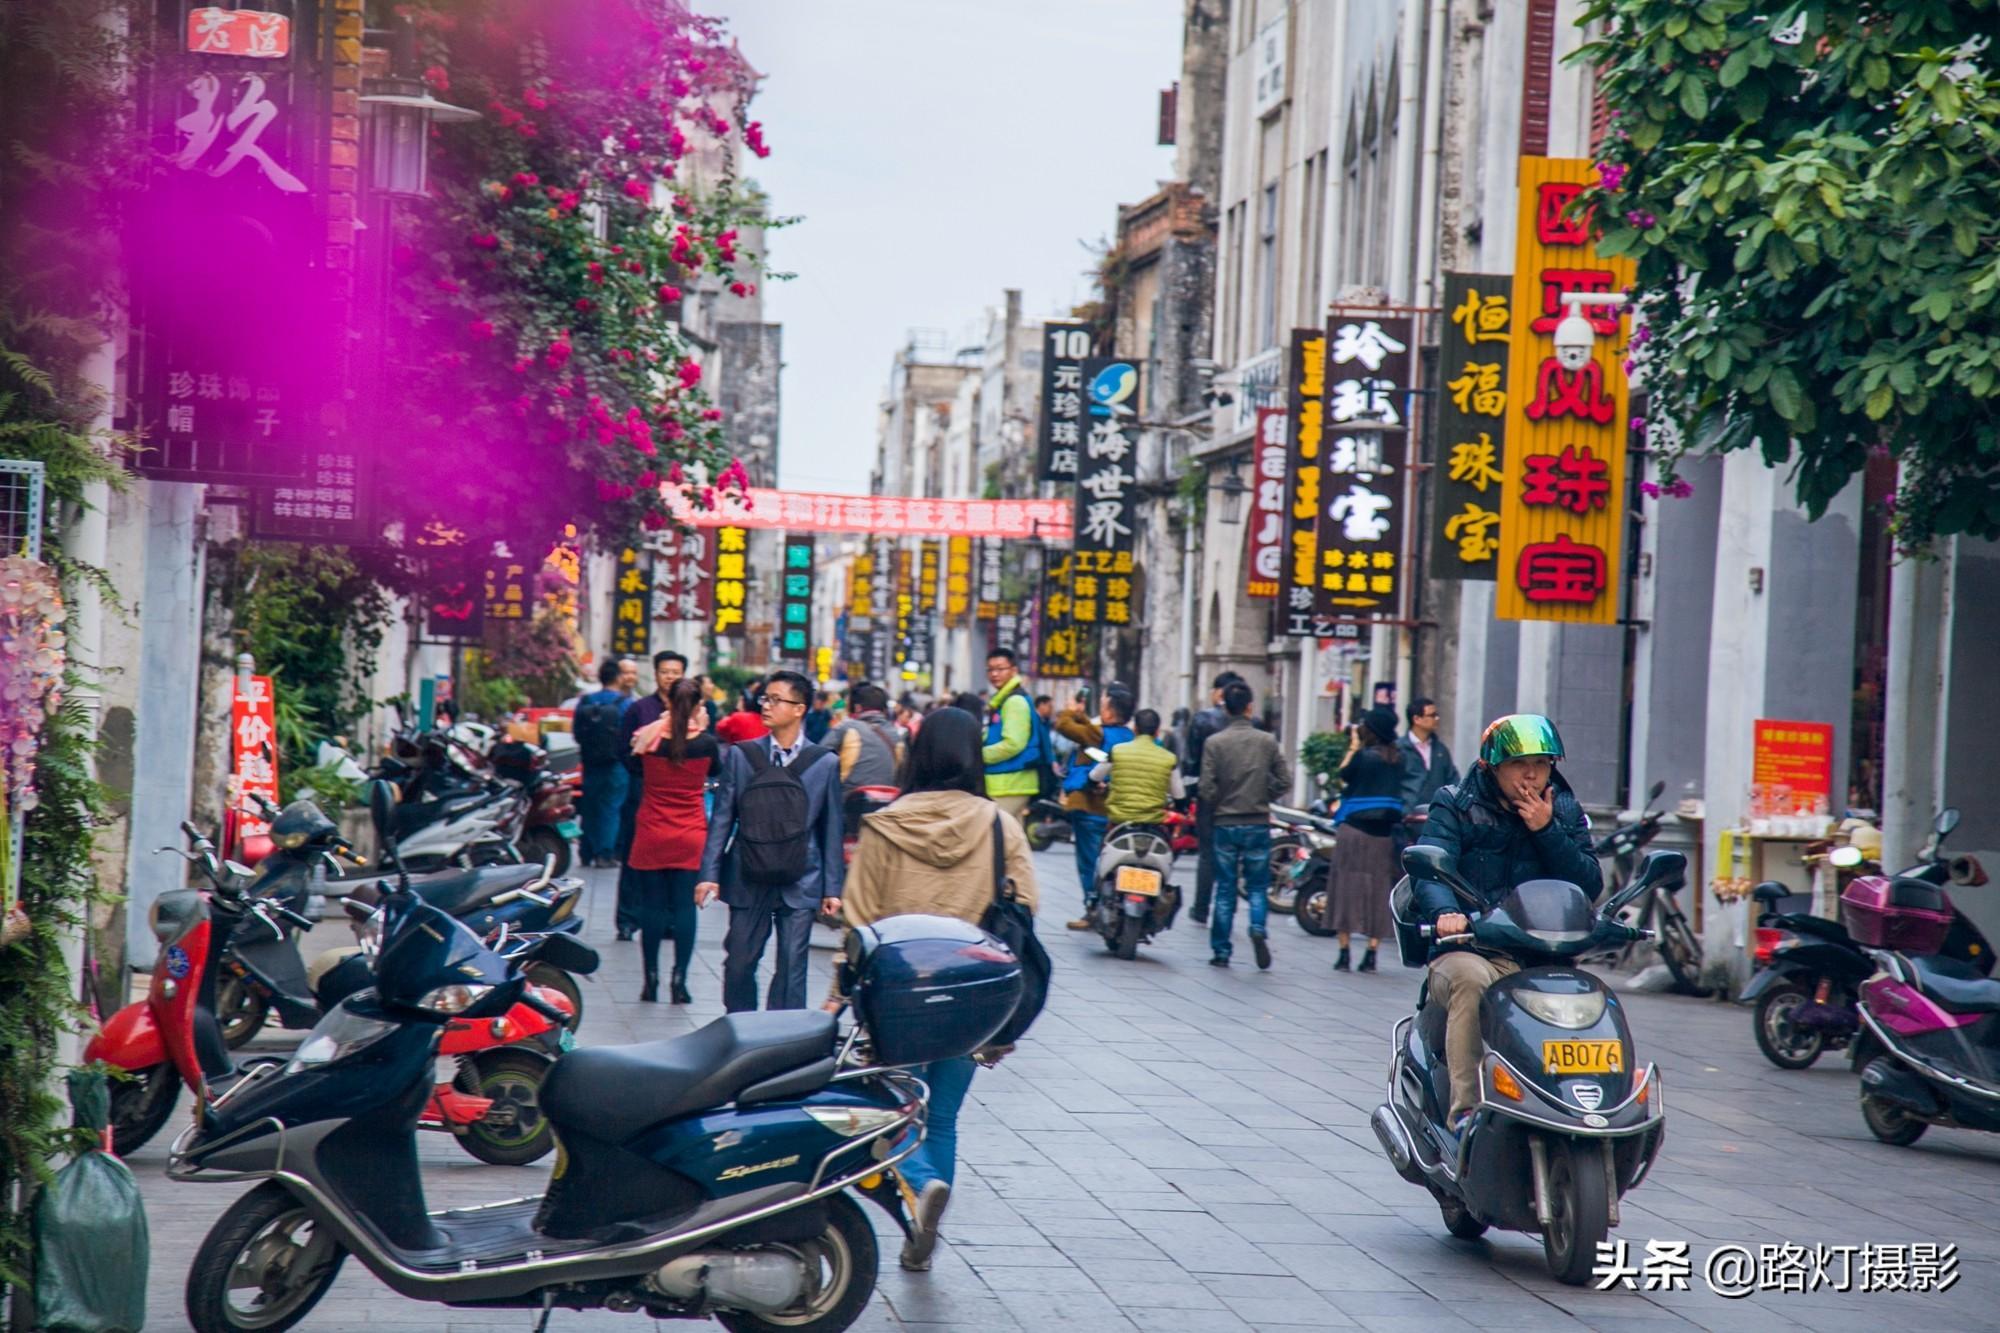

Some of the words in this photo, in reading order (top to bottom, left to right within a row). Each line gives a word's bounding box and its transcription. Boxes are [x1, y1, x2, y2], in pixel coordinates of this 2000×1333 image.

[175, 72, 308, 192] 玖
[1049, 329, 1090, 474] 10元珍珠店
[1444, 288, 1511, 562] 恒福珠宝
[1080, 418, 1134, 548] 海世界
[1074, 550, 1134, 573] 工艺品
[1549, 1044, 1619, 1068] AB076
